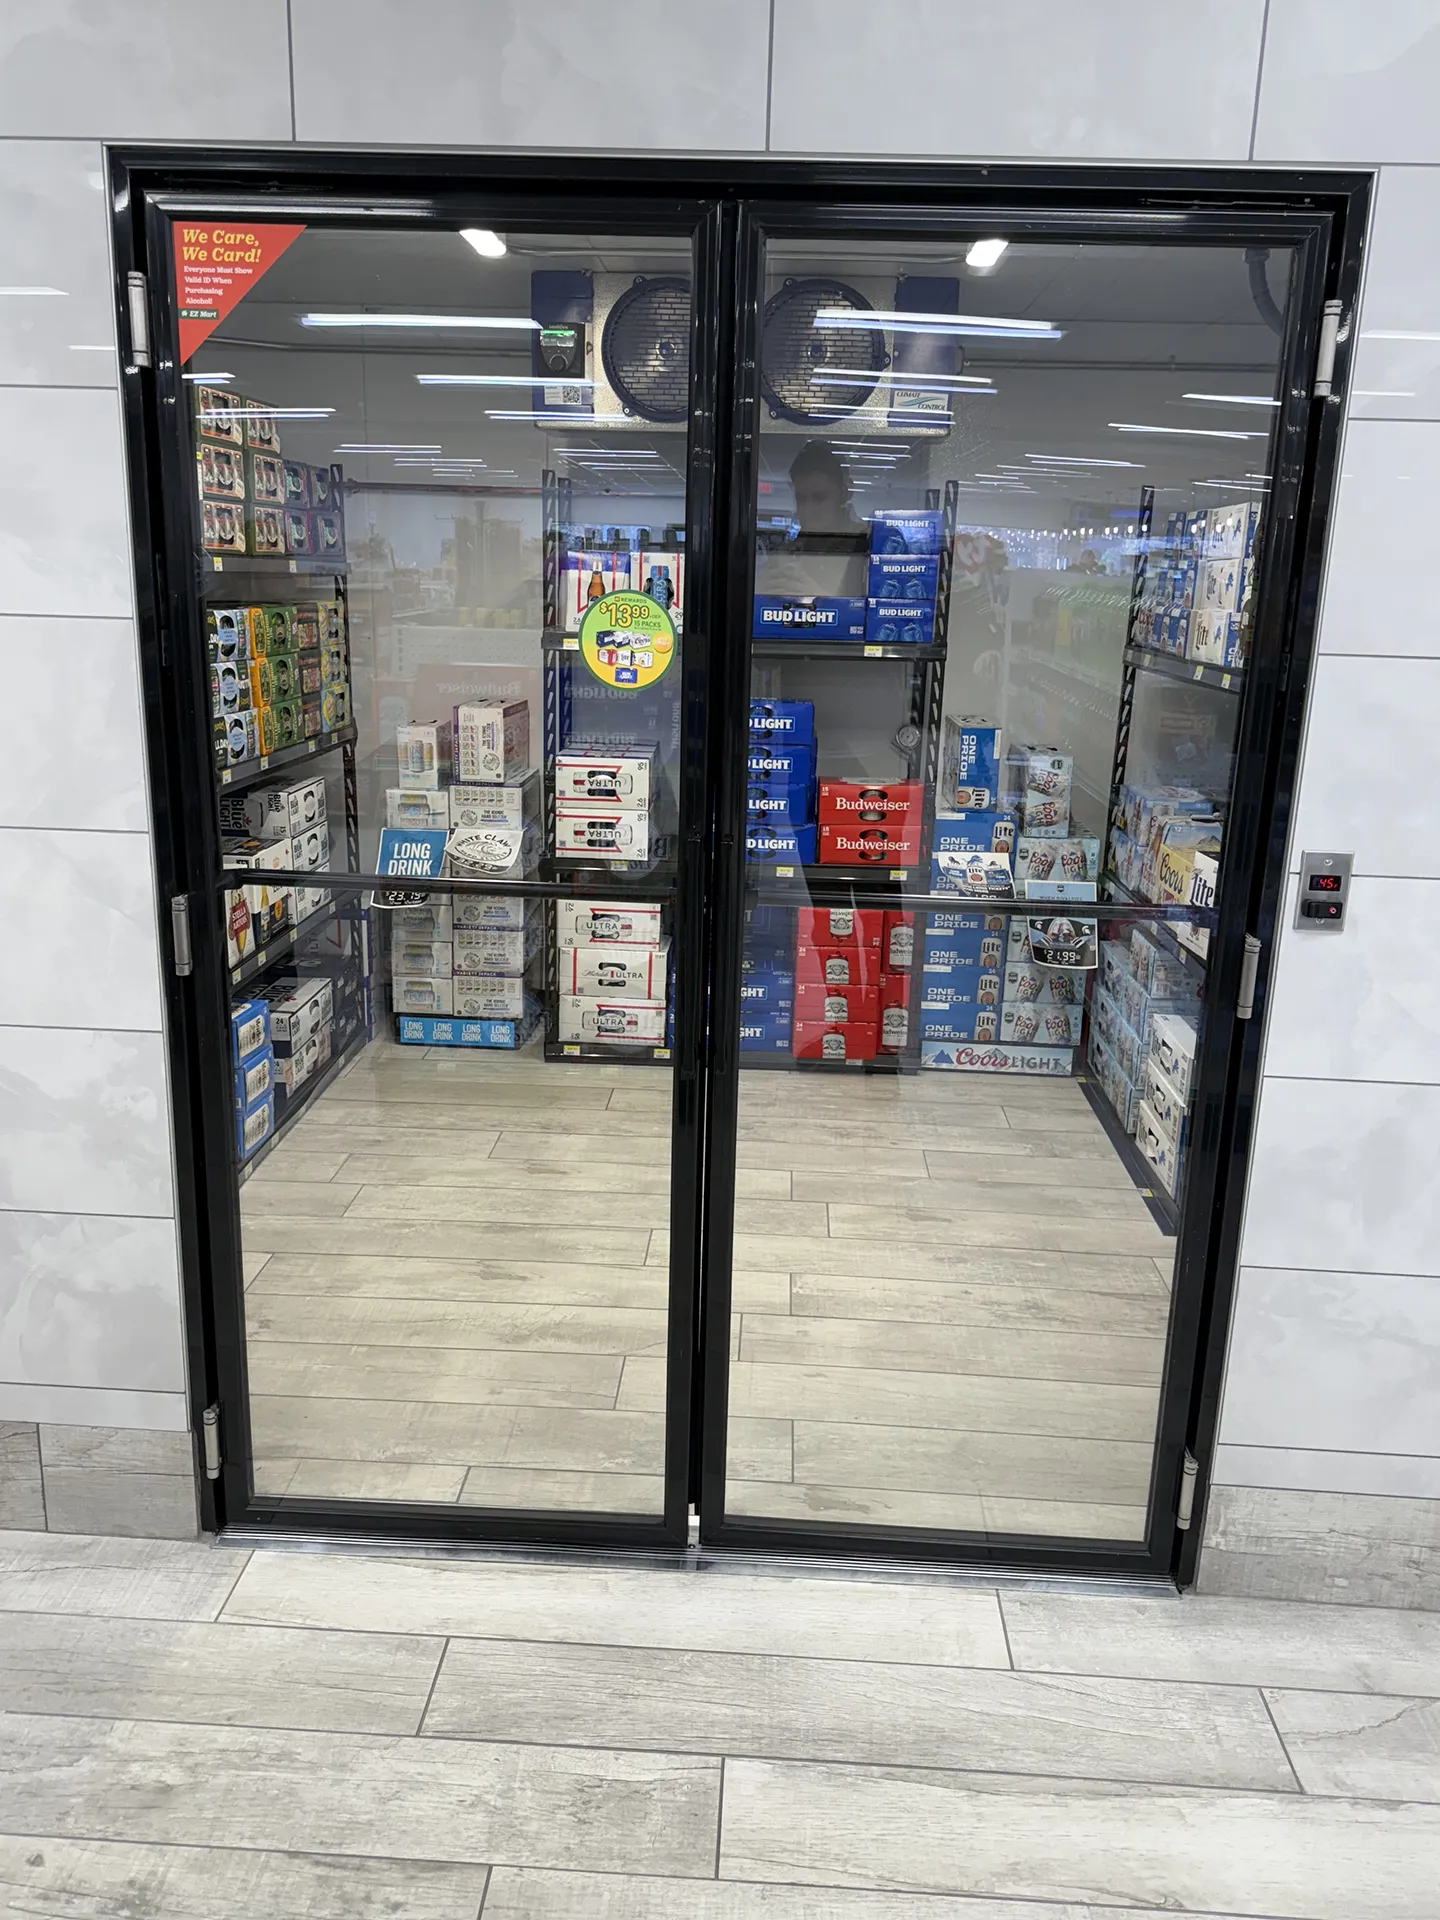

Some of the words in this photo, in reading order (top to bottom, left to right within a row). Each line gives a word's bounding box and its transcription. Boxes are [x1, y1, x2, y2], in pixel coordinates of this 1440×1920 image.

[182, 229, 208, 244] We
[212, 230, 259, 246] Care,
[182, 247, 208, 261] We
[212, 248, 262, 262] Card!
[184, 266, 215, 274] Everyone
[185, 287, 223, 296] Purchasing
[763, 611, 793, 622] BUD
[795, 611, 836, 623] LIGHT
[754, 719, 792, 729] LIGHT
[968, 735, 977, 764] ONE
[960, 735, 969, 780] PRIDE
[752, 759, 790, 769] LIGHT
[972, 788, 985, 808] Lite
[749, 800, 786, 810] LIGHT
[836, 798, 909, 810] Budweiser
[220, 799, 231, 829] LIGHT
[230, 800, 245, 829] Blue
[994, 826, 1014, 839] Lite
[758, 839, 795, 849] LIGHT
[836, 838, 910, 850] Budweiser
[393, 843, 430, 859] LONG
[388, 860, 433, 875] DRINK
[1160, 852, 1184, 894] Coors
[231, 907, 246, 919] STELLA
[982, 941, 1001, 953] Lite
[980, 979, 998, 990] Lite
[405, 1022, 423, 1030] LONG
[434, 1023, 452, 1031] LONG
[593, 1017, 624, 1026] ULTRA
[977, 1016, 996, 1027] Lite
[463, 1024, 480, 1033] LONG
[492, 1025, 510, 1034] LONG
[404, 1030, 424, 1040] DRINK
[433, 1031, 453, 1040] DRINK
[462, 1033, 482, 1042] DRINK
[490, 1034, 511, 1043] DRINK
[956, 1048, 1010, 1067] Coors
[1011, 1056, 1060, 1069] LIGHT
